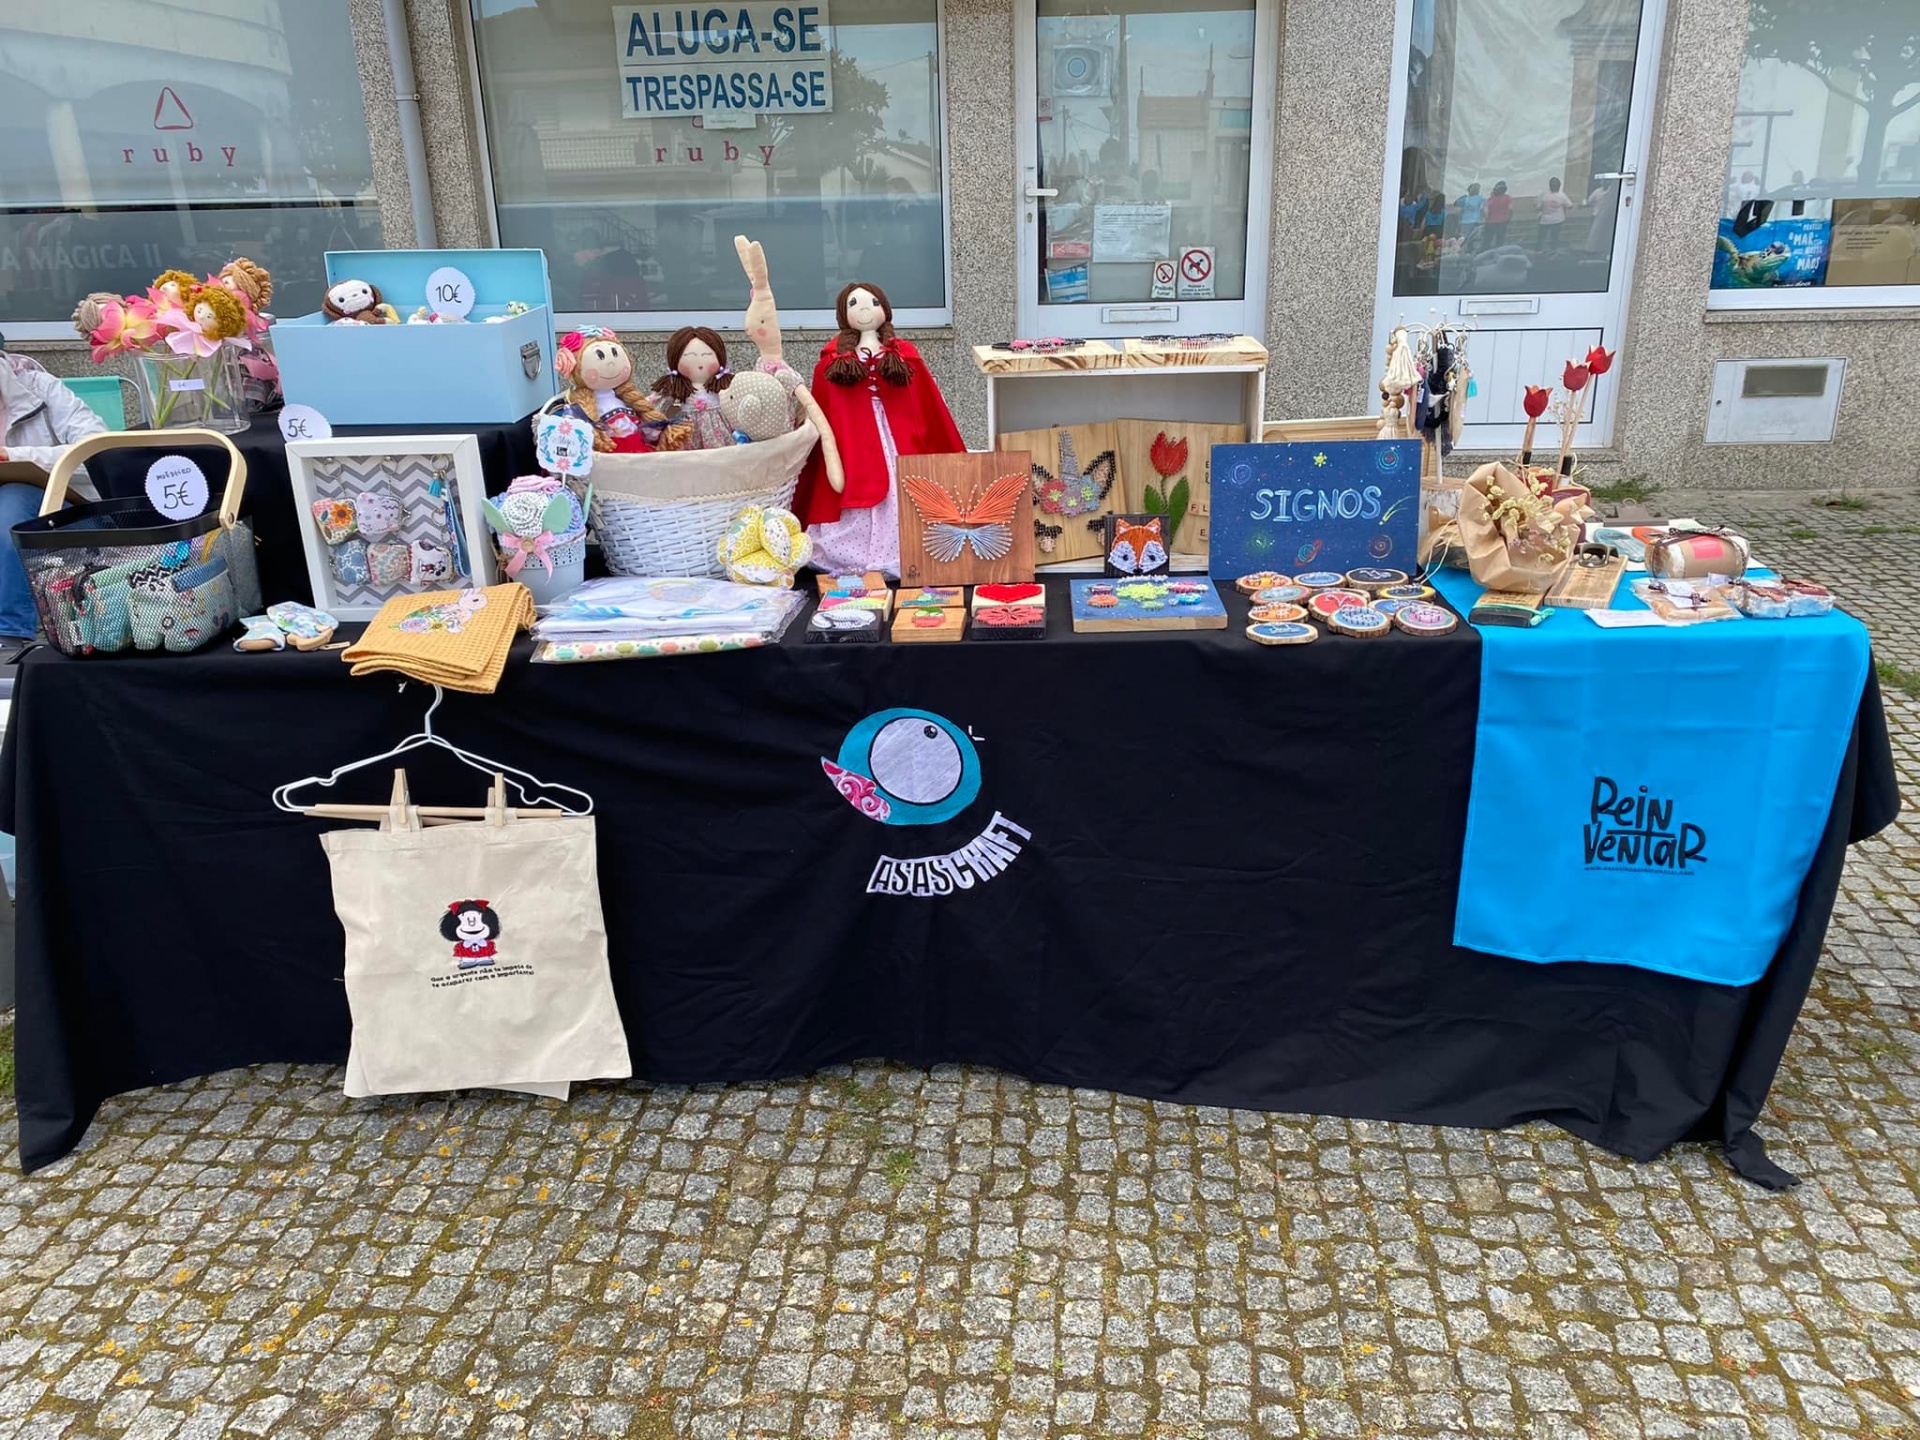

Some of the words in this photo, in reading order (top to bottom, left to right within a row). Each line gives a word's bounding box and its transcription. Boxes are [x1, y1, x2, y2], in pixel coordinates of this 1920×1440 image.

[626, 7, 821, 57] ALUGA-SE
[626, 71, 826, 112] TRESPASSA-SE
[123, 142, 237, 167] ruby
[656, 141, 775, 166] ruby
[435, 283, 462, 304] 10€
[287, 418, 313, 439] 5€
[163, 480, 195, 510] 5€
[1250, 485, 1382, 522] SIGNOS
